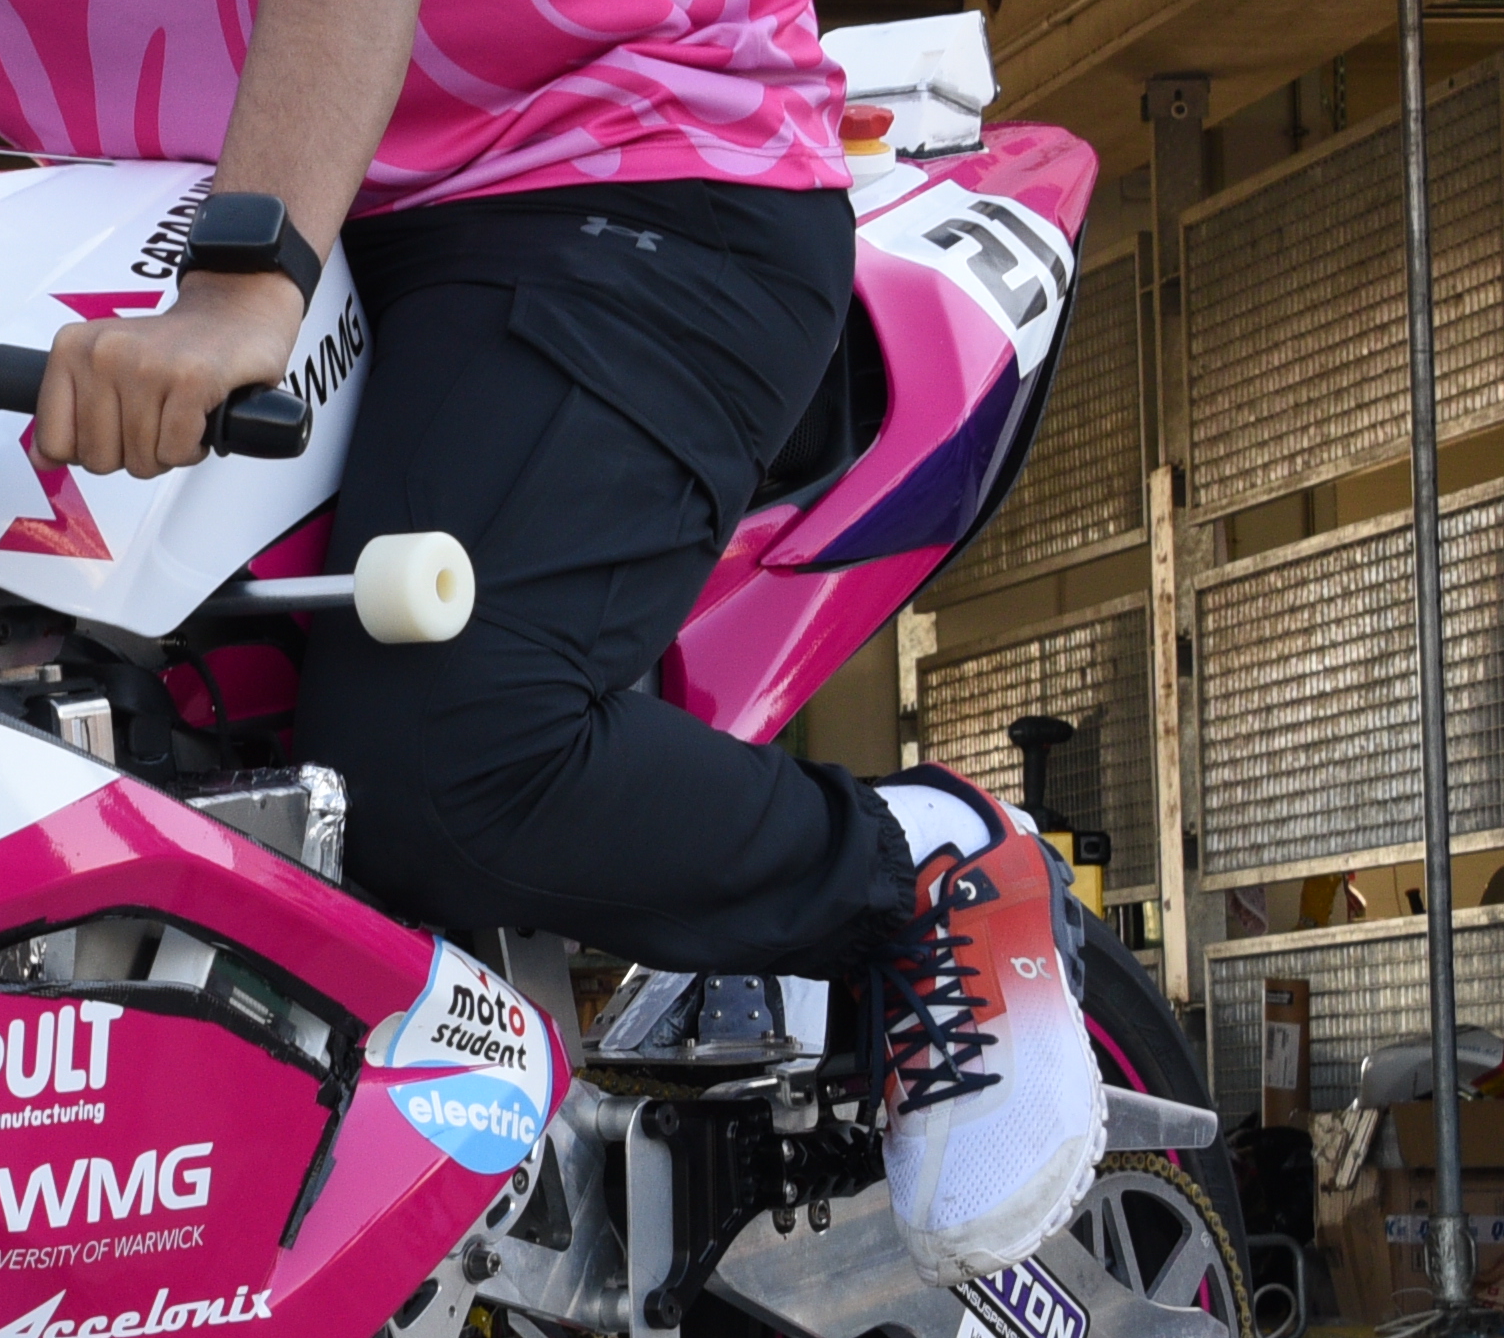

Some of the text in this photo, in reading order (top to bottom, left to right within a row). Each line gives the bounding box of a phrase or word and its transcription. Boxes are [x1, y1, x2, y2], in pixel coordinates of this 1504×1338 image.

[922, 199, 1068, 330] 21
[448, 984, 525, 1037] moto
[431, 1023, 527, 1072] student
[408, 1090, 536, 1145] electric
[82, 1239, 111, 1263] OF
[114, 1224, 205, 1258] WARWICK
